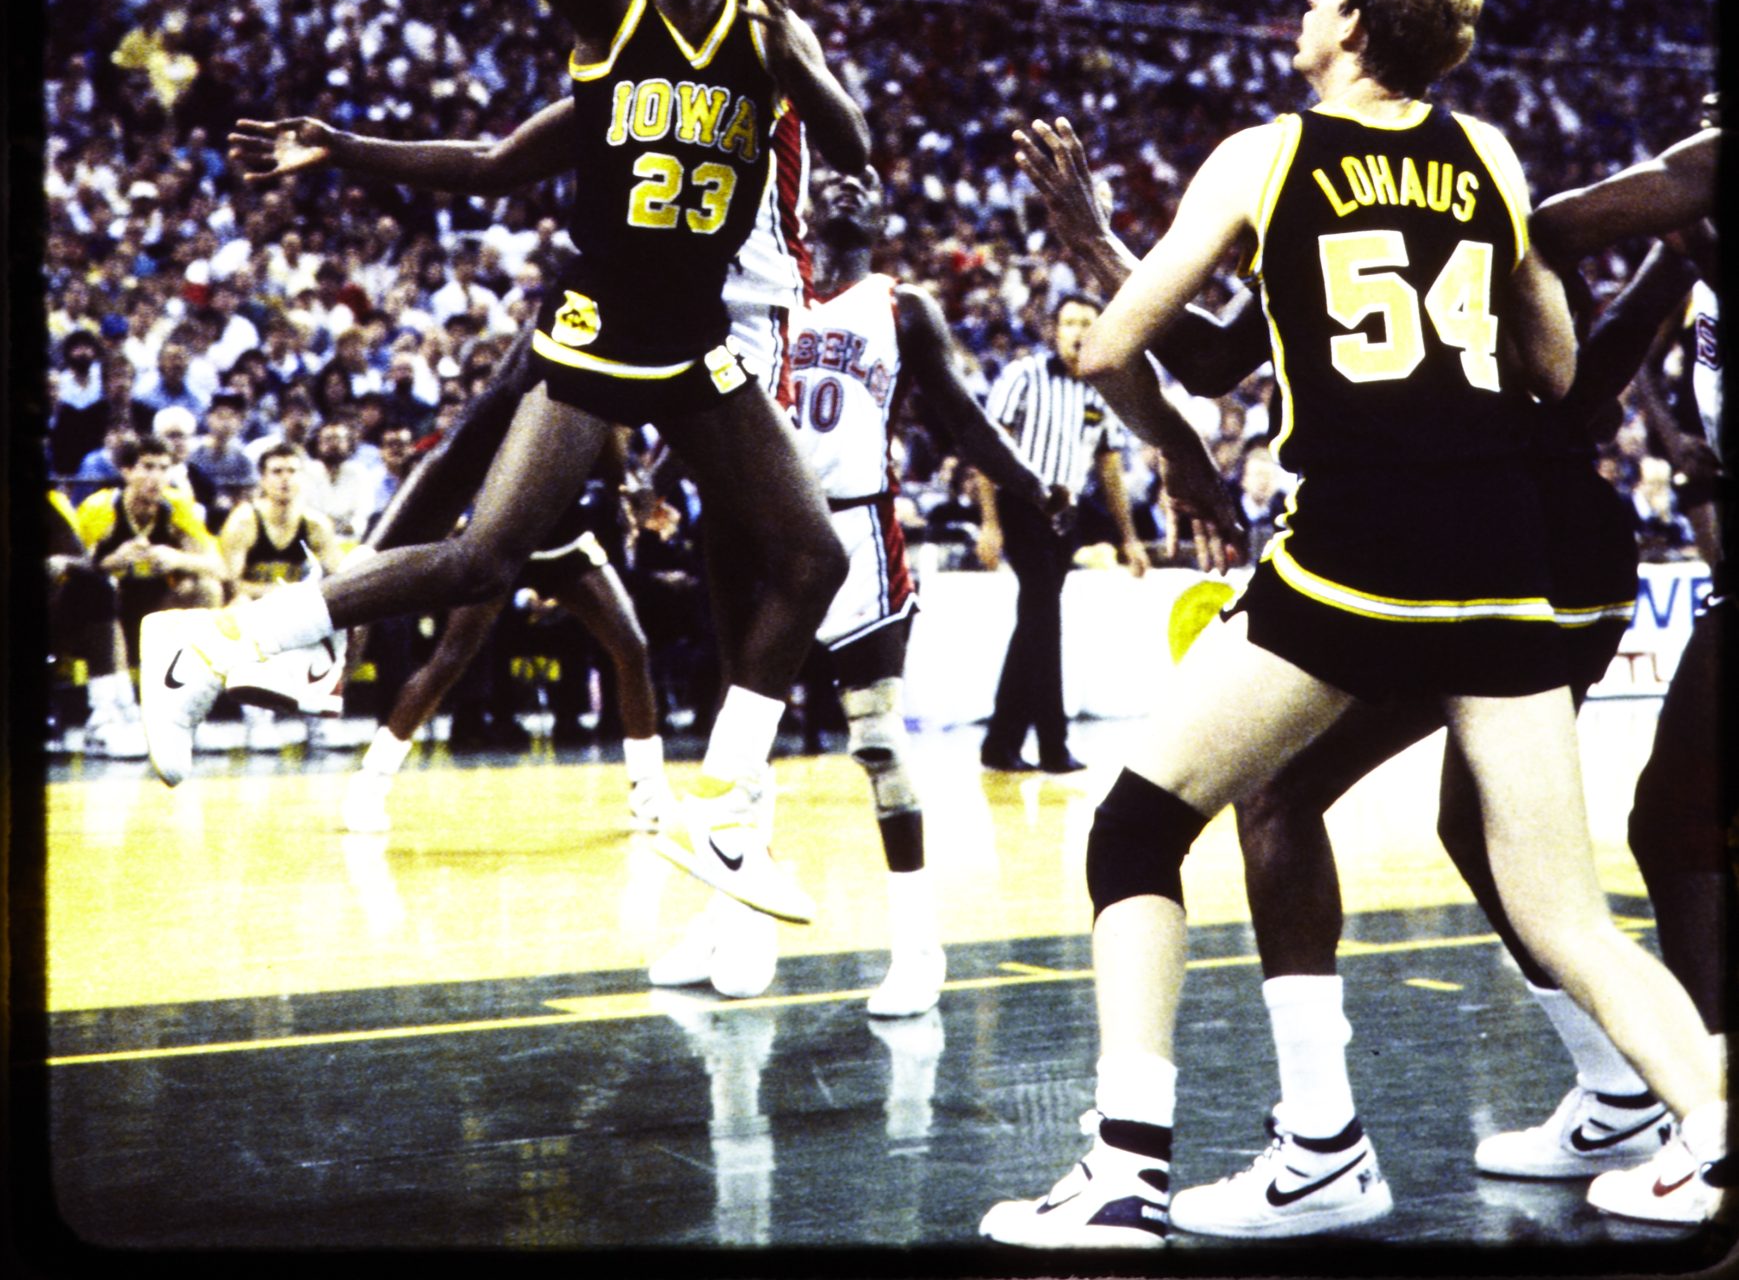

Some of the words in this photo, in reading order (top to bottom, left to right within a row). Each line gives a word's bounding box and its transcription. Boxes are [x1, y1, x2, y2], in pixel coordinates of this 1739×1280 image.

[606, 78, 760, 163] IOWA
[627, 151, 738, 235] 23
[1312, 154, 1480, 222] LOHAUS
[1317, 229, 1501, 393] 54
